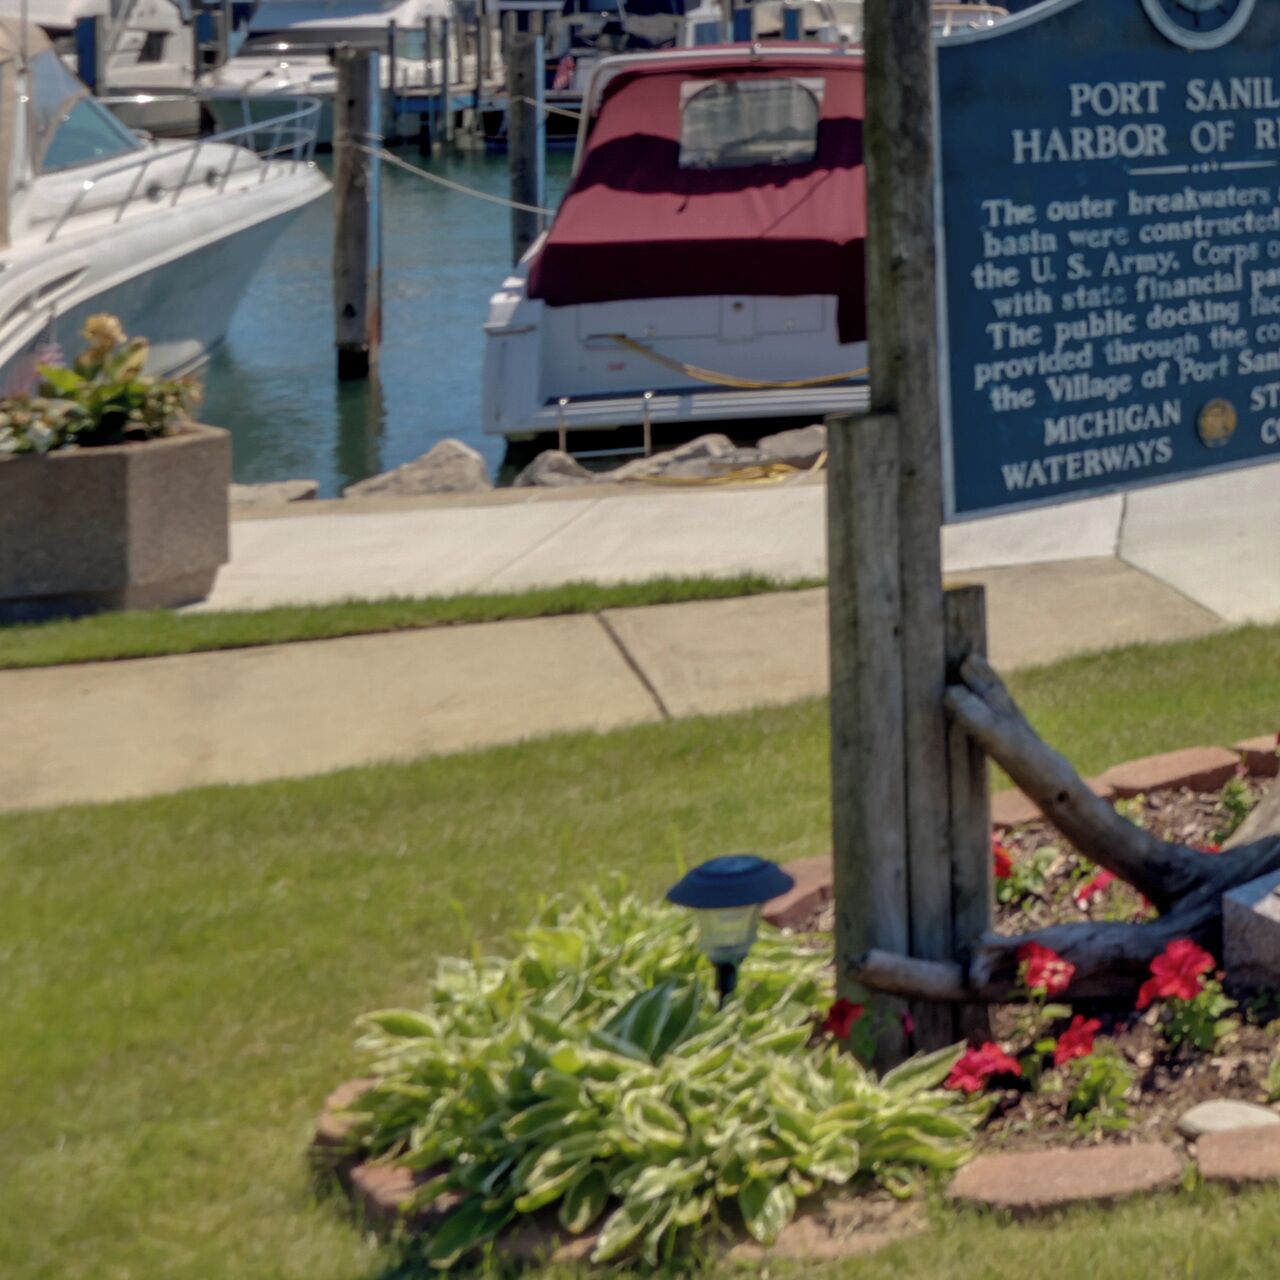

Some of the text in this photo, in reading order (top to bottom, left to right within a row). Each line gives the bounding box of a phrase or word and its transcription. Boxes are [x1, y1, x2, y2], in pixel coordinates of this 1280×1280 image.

[1069, 80, 1166, 117] PORT
[1011, 123, 1168, 164] HARBOR
[1190, 120, 1235, 153] OF
[981, 198, 1037, 227] The
[1046, 194, 1118, 222] outer
[1128, 185, 1270, 216] breakwaters
[984, 228, 1058, 258] basin
[1068, 226, 1130, 248] were
[1138, 206, 1280, 244] constructed
[971, 261, 1020, 290] the
[1030, 256, 1057, 283] U.
[1066, 253, 1092, 280] S.
[1192, 240, 1259, 271] Corps
[991, 288, 1053, 318] with
[1061, 284, 1127, 311] state
[1135, 266, 1243, 303] financial
[985, 321, 1042, 351] The
[1054, 308, 1136, 352] public
[1146, 298, 1240, 330] docking
[974, 342, 1094, 390] provided
[1104, 331, 1200, 365] through
[1208, 324, 1248, 350] the
[990, 383, 1036, 412] the
[1046, 372, 1133, 402] Village
[1141, 361, 1170, 389] of
[1178, 353, 1229, 385] Port
[1043, 397, 1182, 447] MICHIGAN
[1001, 436, 1173, 492] WATERWAYS
